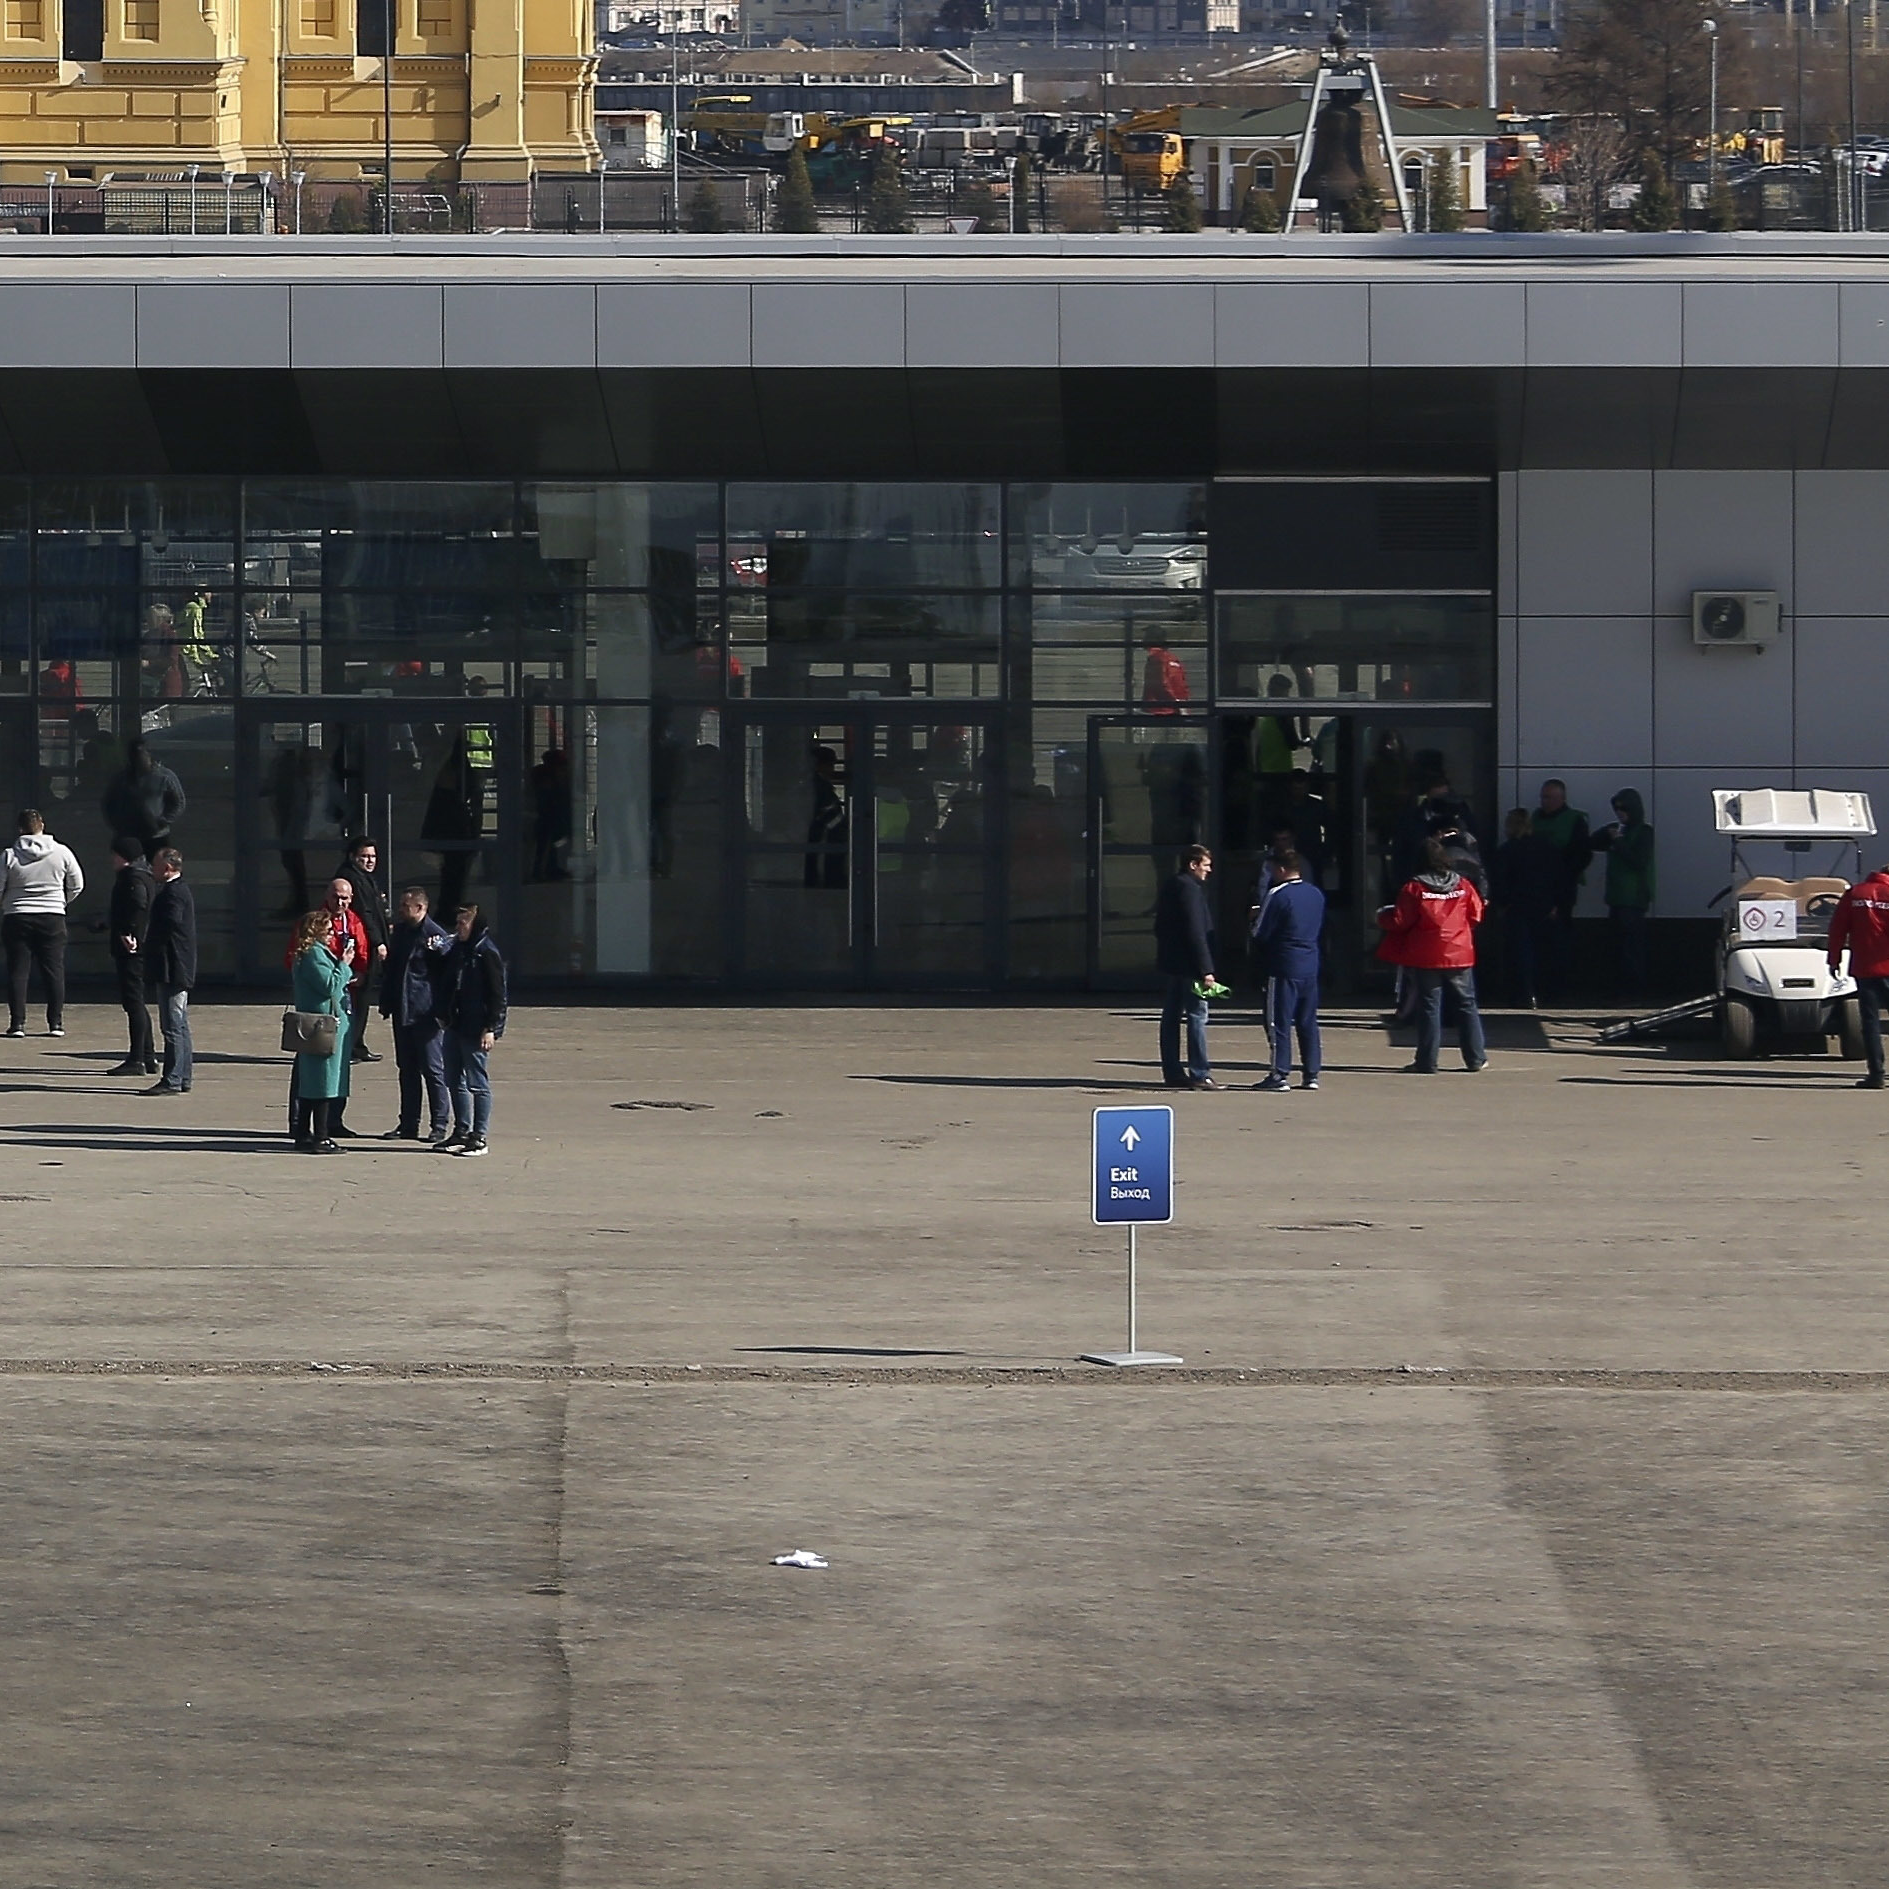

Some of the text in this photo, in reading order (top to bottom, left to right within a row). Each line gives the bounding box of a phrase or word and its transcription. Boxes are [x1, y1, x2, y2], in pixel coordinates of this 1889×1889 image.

[1773, 910, 1786, 928] 2
[1111, 1168, 1138, 1181] Exit
[1111, 1187, 1150, 1200] Выход
